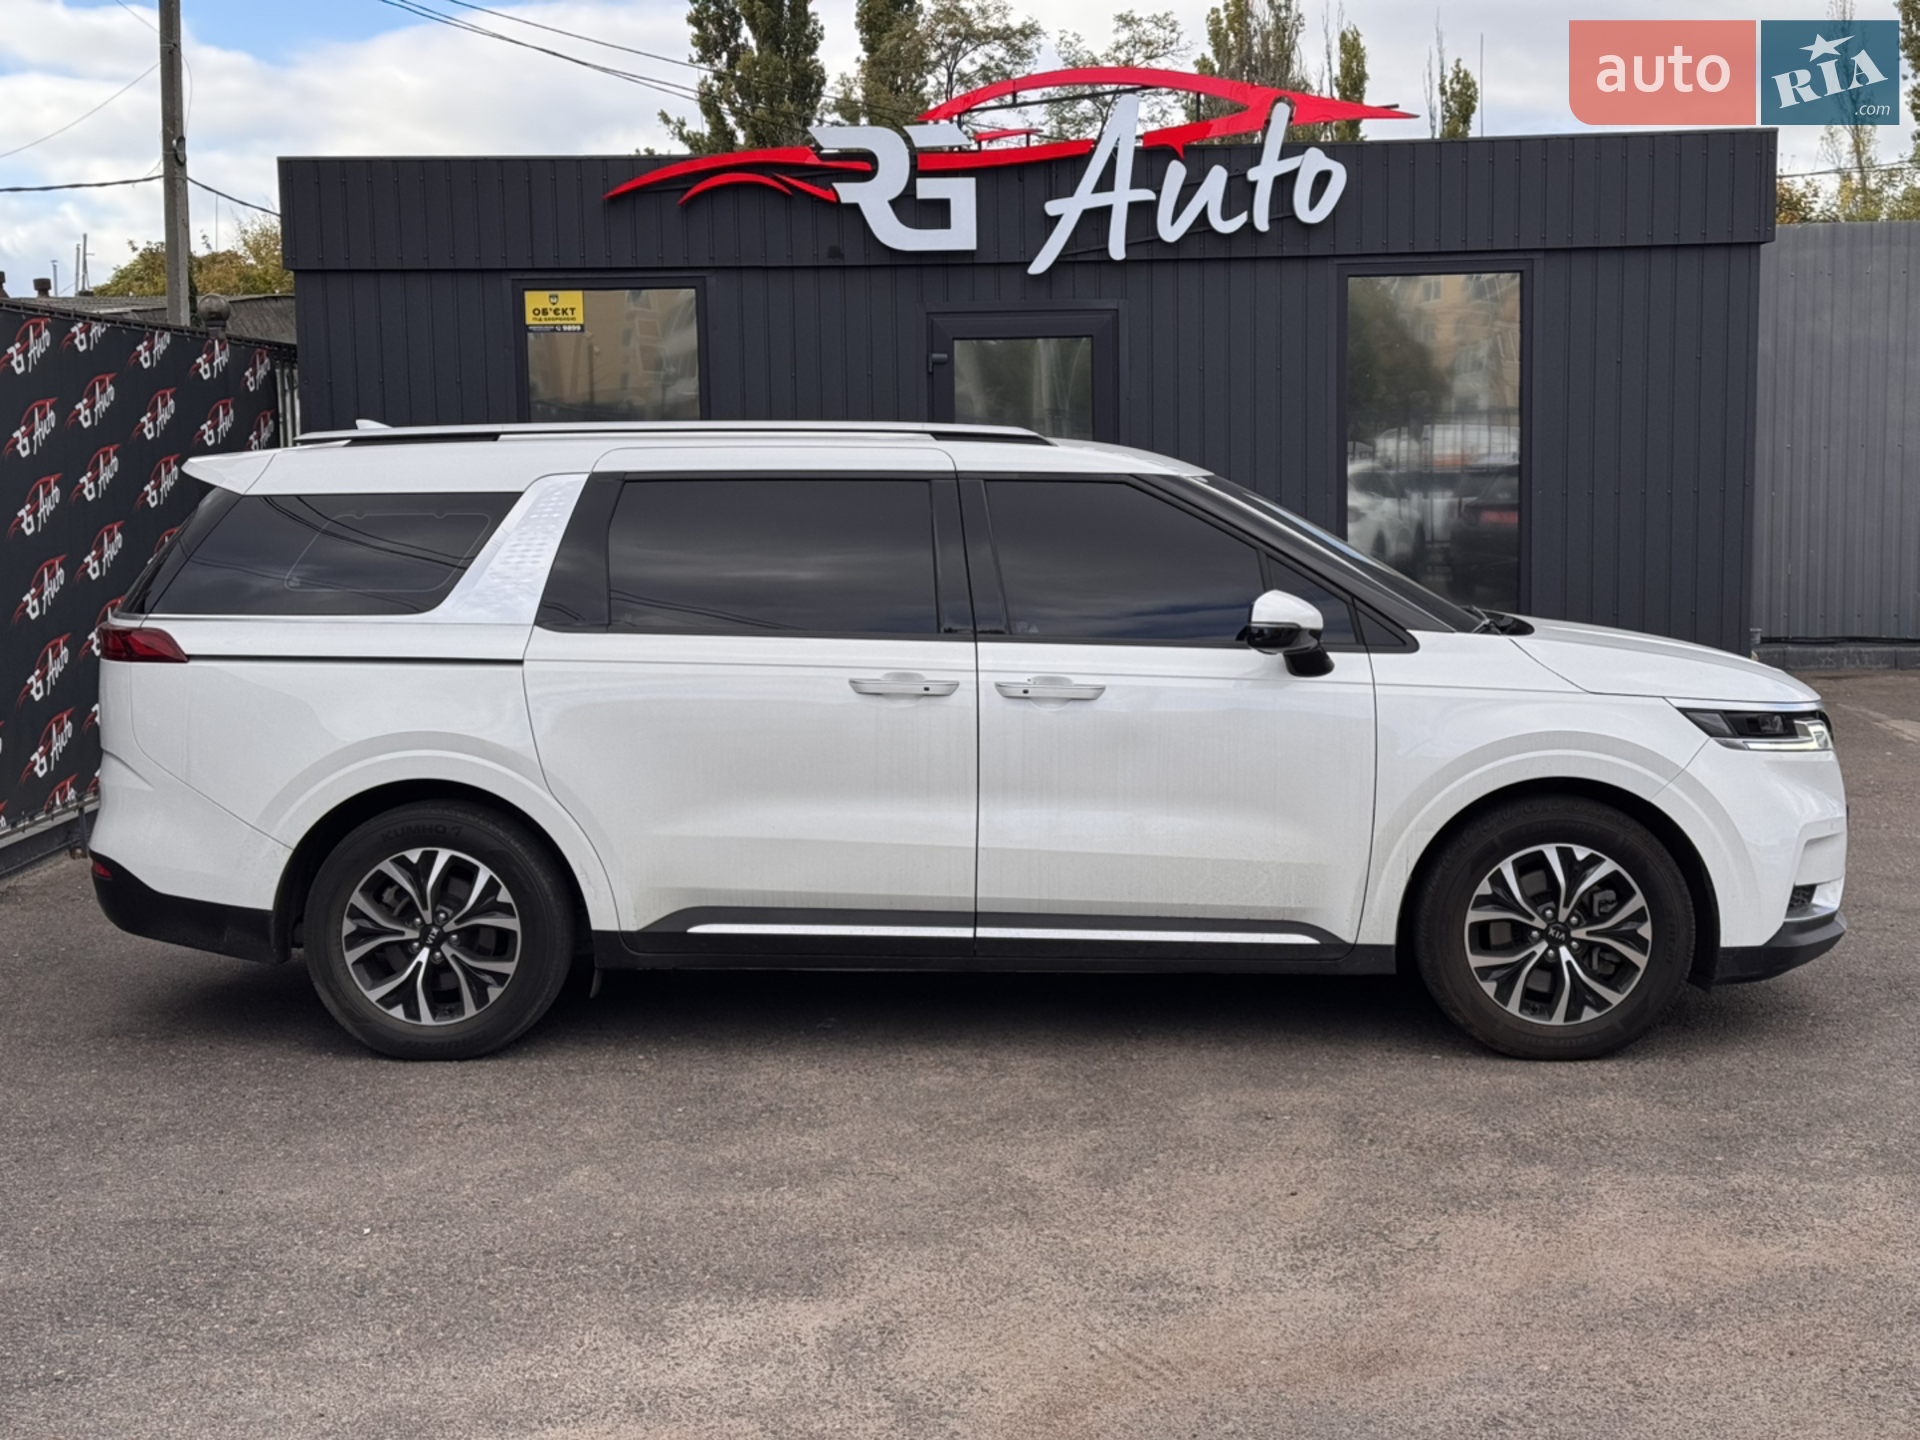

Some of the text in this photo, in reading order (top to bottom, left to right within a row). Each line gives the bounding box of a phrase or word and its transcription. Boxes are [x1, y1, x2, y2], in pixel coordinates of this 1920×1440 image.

[809, 94, 1347, 276] RG Auto
[28, 320, 51, 373] Auto
[94, 377, 115, 426] Auto
[156, 391, 175, 438] Auto
[33, 401, 56, 455] Auto
[98, 448, 119, 498] Auto
[160, 458, 179, 505] Auto
[38, 477, 61, 532] Auto
[102, 525, 123, 576] Auto
[42, 560, 65, 615] Auto
[47, 640, 69, 695] Auto
[50, 714, 73, 771] Auto
[381, 824, 447, 843] KUMHO
[426, 928, 439, 944] KIA
[1548, 928, 1566, 941] KIA
